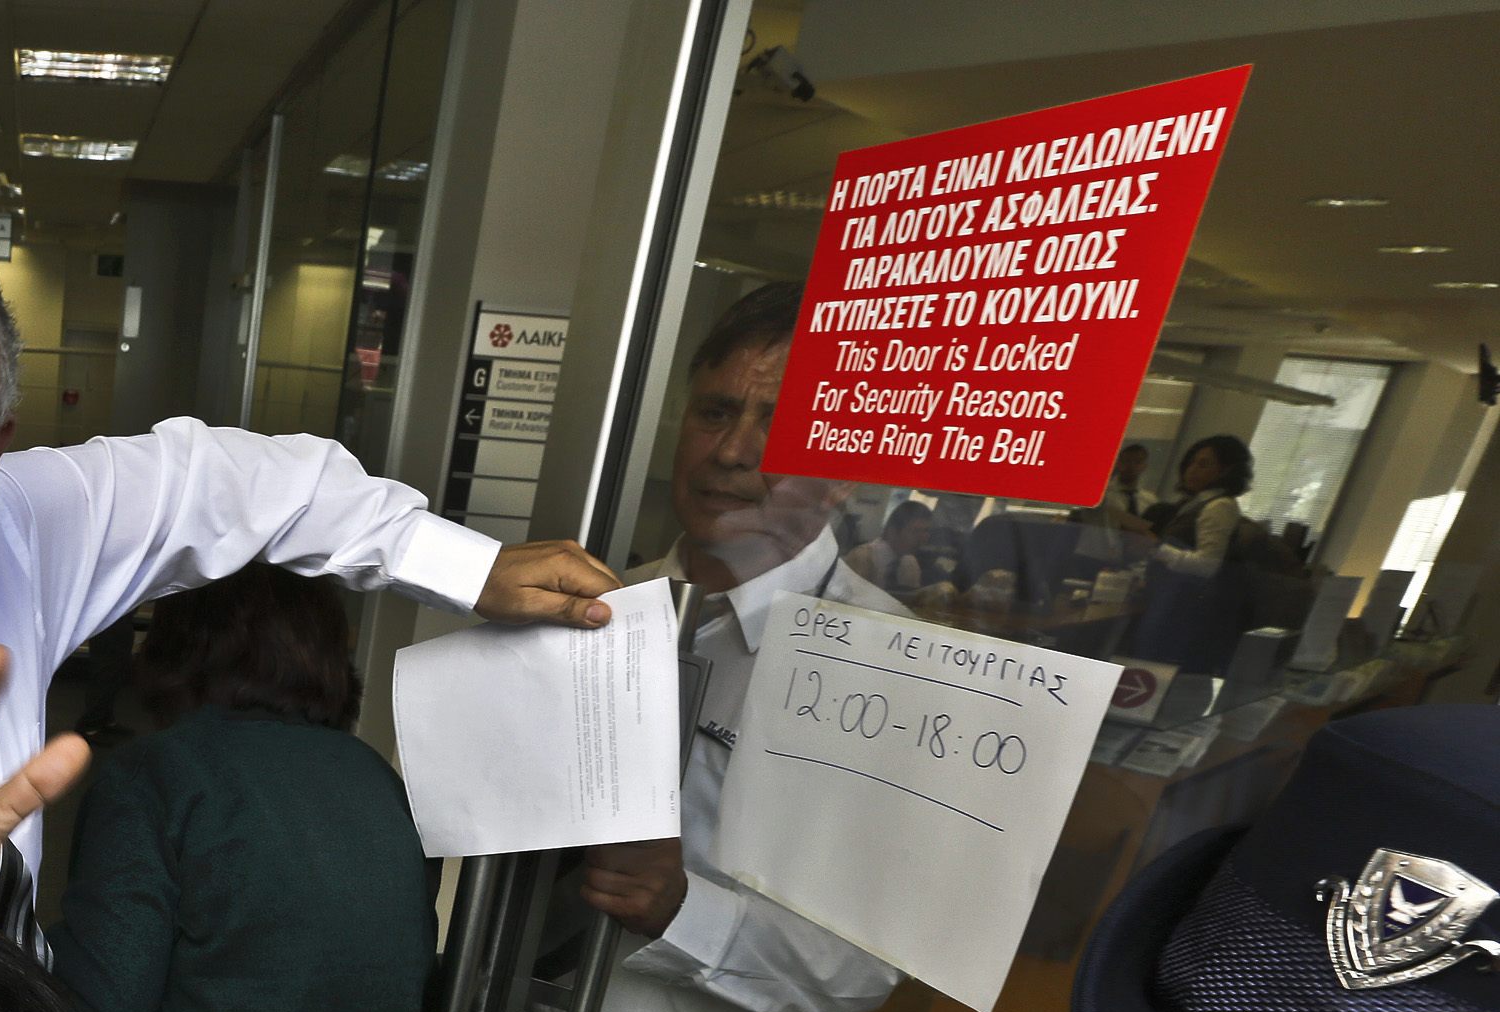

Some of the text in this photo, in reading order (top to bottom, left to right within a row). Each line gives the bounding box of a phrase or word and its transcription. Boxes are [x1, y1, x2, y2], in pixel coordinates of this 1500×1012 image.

[829, 106, 1228, 212] Η ΠΟΡΤΑ ΕΙΝΑΙ ΚΛΕΙΔΩΜΕΝΗ
[840, 172, 1160, 251] ΓΙΑ ΛΟΓΟΥΣ ΑΣΦΑΛΕΙΑΣ.
[844, 228, 1127, 291] ΠΑΡΑΚΑΛΟΥΜΕ ΟΠΩΣ
[809, 278, 1140, 334] ΚΤΥΠΗΣΕΤΕ ΤΟ ΚΟΥΔΟΥΝΙ.
[835, 333, 1080, 373] This Door is Locked
[812, 381, 1067, 422] For Security Reasons.
[806, 420, 1046, 466] Please Ring The Bell.
[887, 631, 1068, 706] ΛΕΙΤΟΥΡΓΙΑΣ
